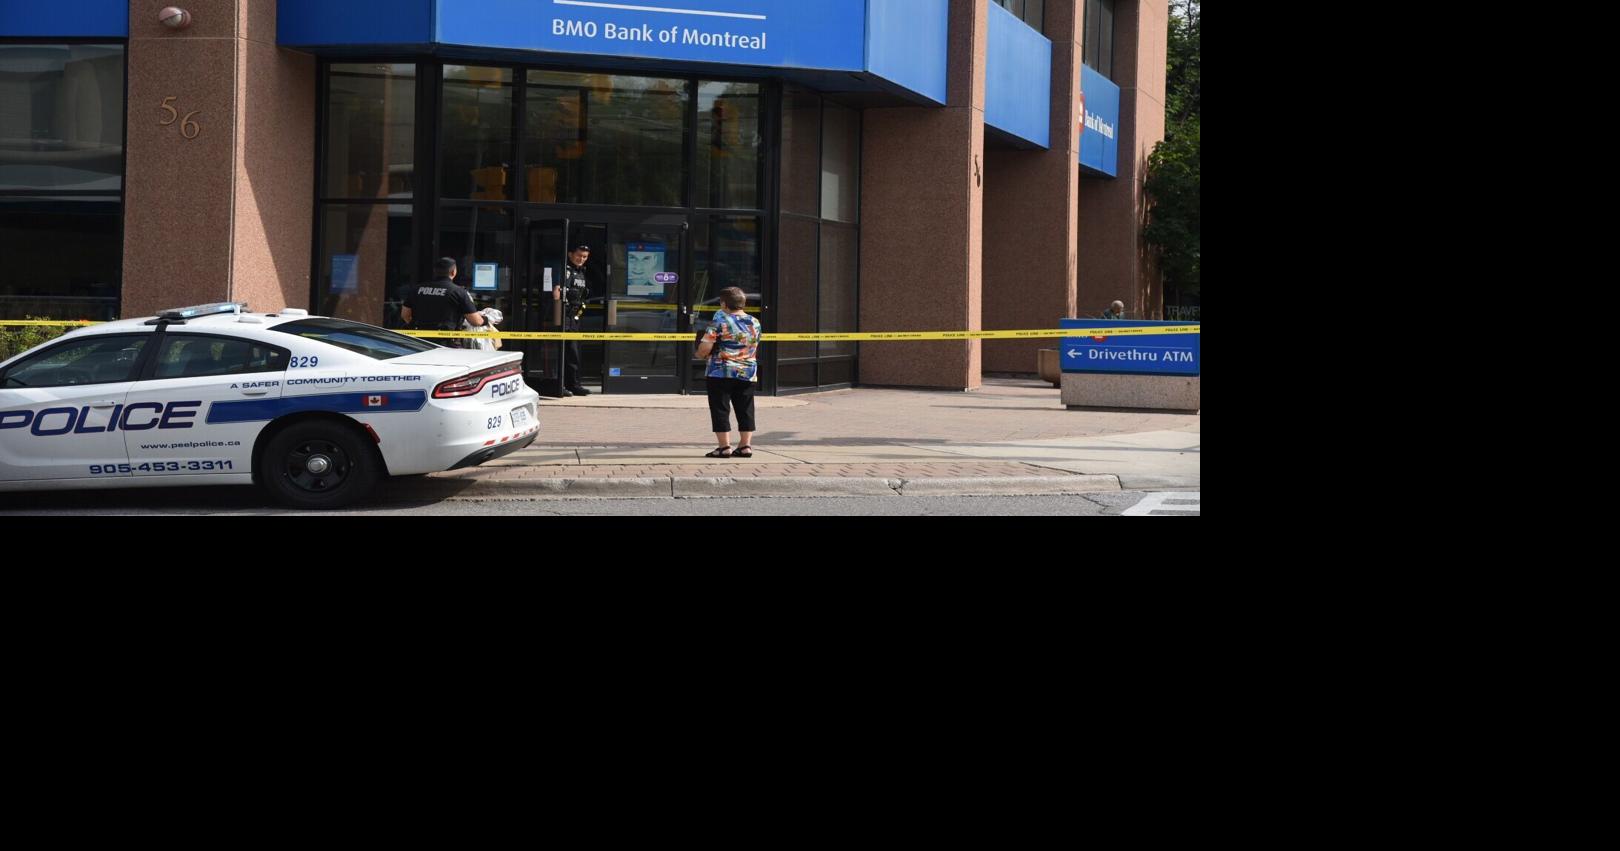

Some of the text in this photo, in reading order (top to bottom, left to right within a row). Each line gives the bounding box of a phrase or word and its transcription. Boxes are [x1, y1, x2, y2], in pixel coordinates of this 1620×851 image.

[552, 18, 767, 50] BMO Bank of Montreal
[159, 95, 201, 139] 56
[1084, 109, 1094, 129] Bank
[418, 286, 447, 296] POLICE
[1166, 305, 1200, 316] TRAVE
[289, 356, 318, 367] 829
[1088, 349, 1193, 362] Drivethru ATM
[287, 376, 357, 385] COMMUNITY
[491, 379, 519, 398] POLICE
[0, 401, 202, 436] POLICE
[487, 415, 502, 429] 829
[141, 440, 241, 449] www.peelpolice.ca
[89, 460, 233, 475] 905-453-3311
